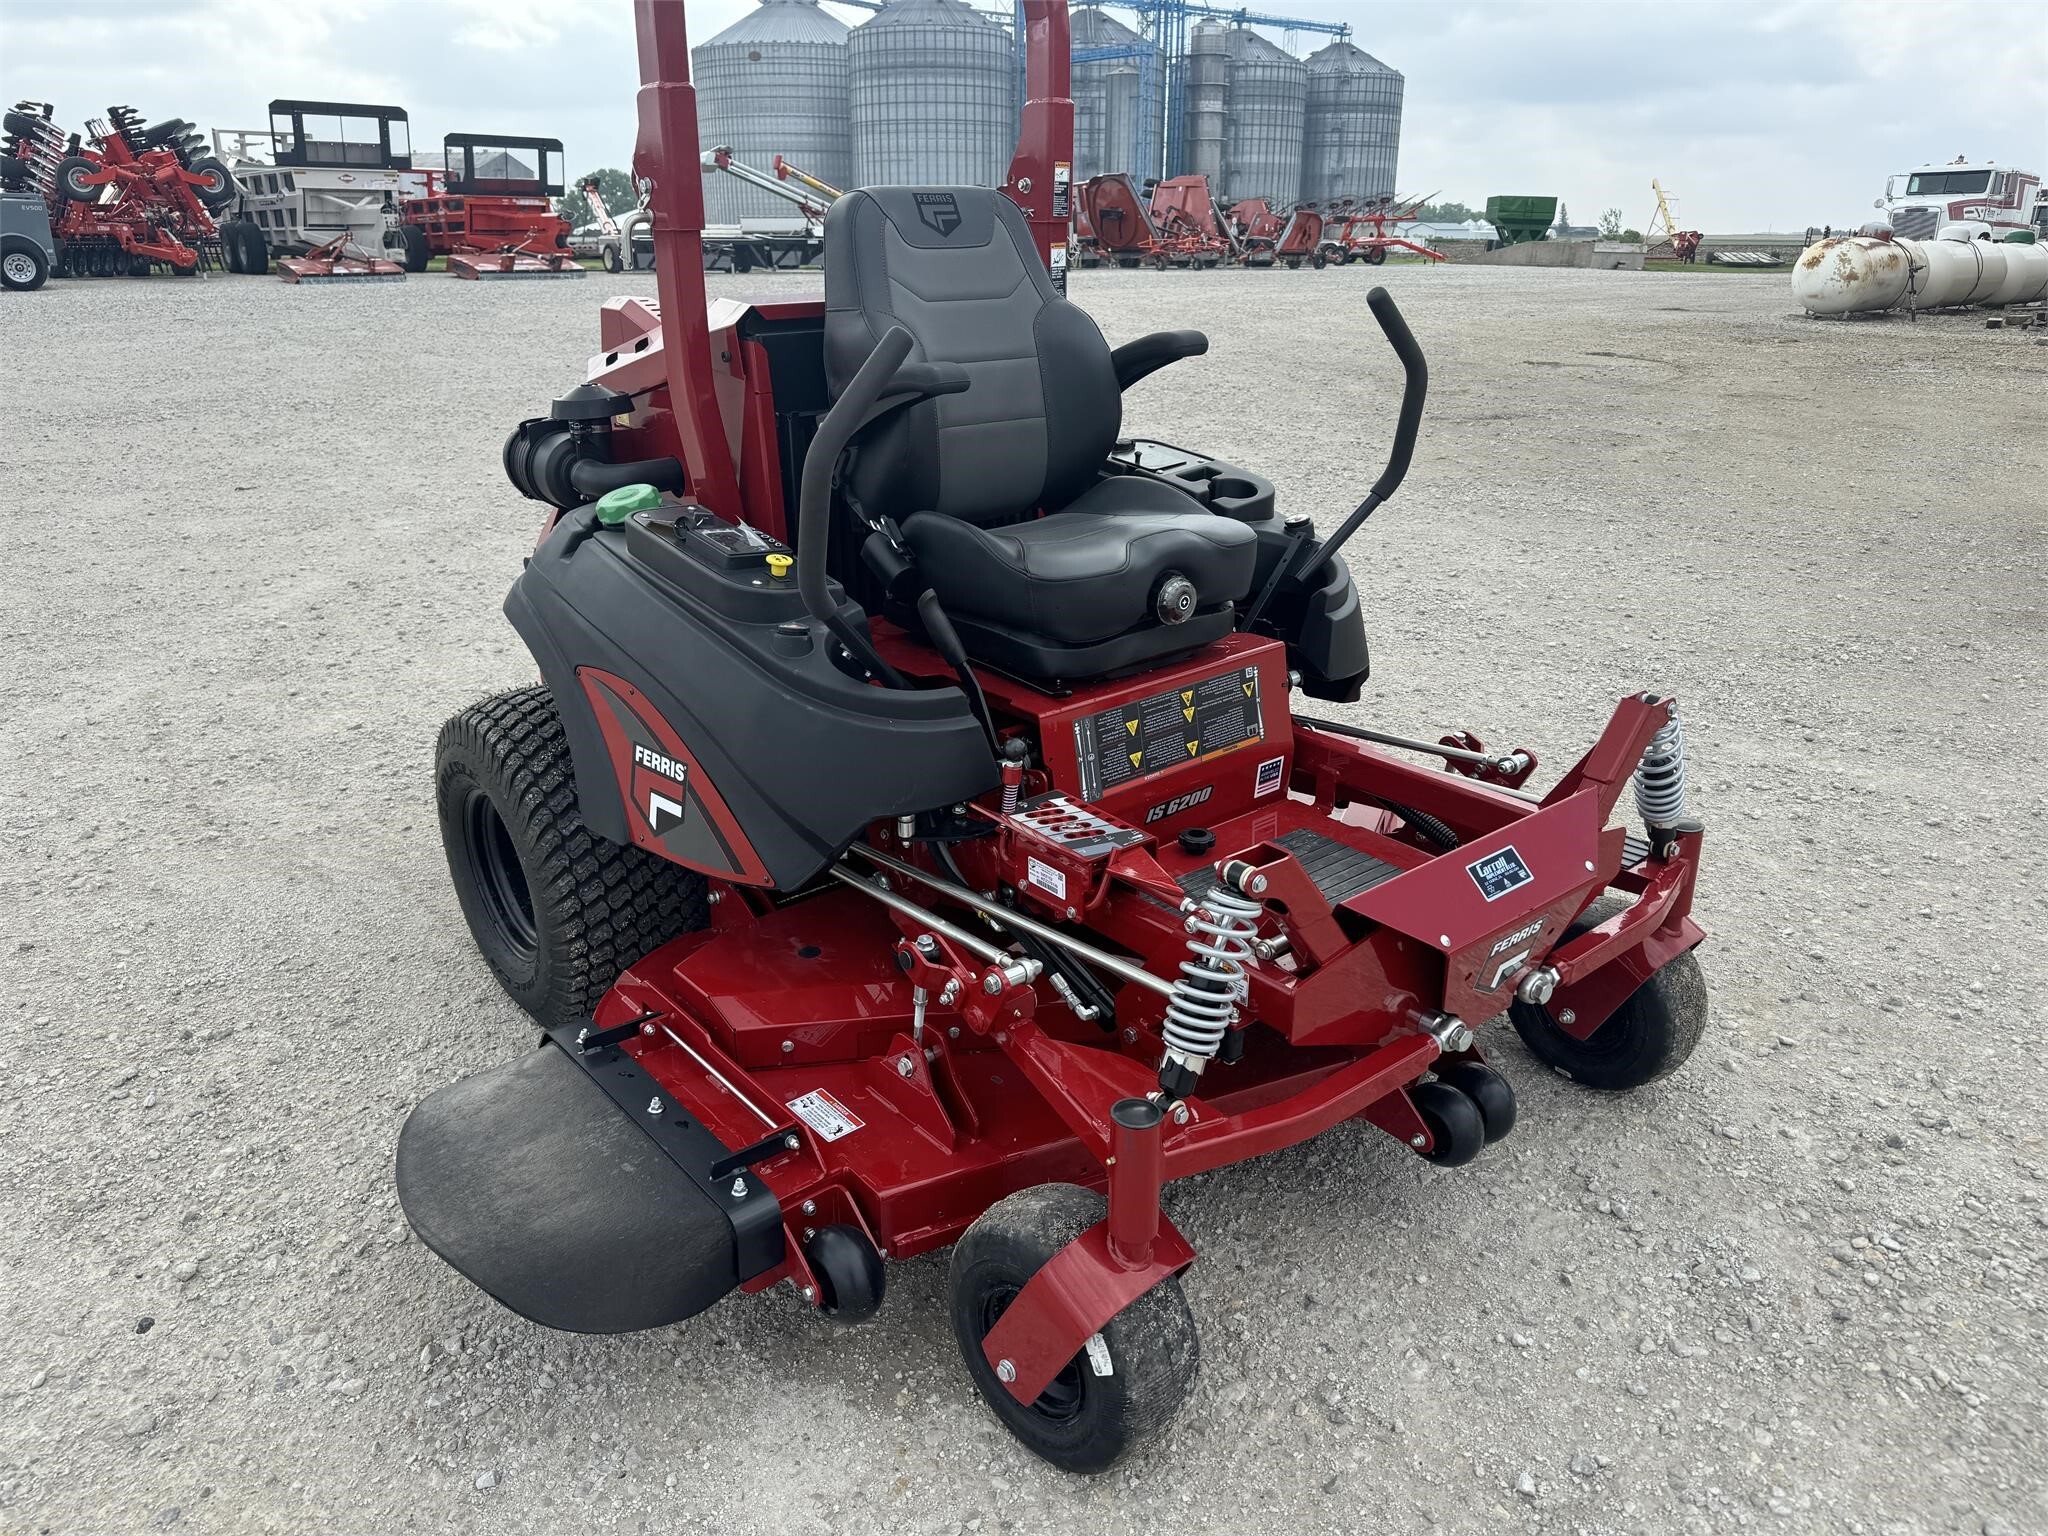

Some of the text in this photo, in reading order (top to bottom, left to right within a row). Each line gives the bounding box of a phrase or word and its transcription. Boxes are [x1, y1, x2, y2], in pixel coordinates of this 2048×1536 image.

[917, 194, 953, 203] FERRIS
[635, 744, 686, 782] FERRIS
[1145, 786, 1213, 824] IS 6200
[1476, 856, 1509, 877] Carroll
[1491, 920, 1542, 956] FERRIS
